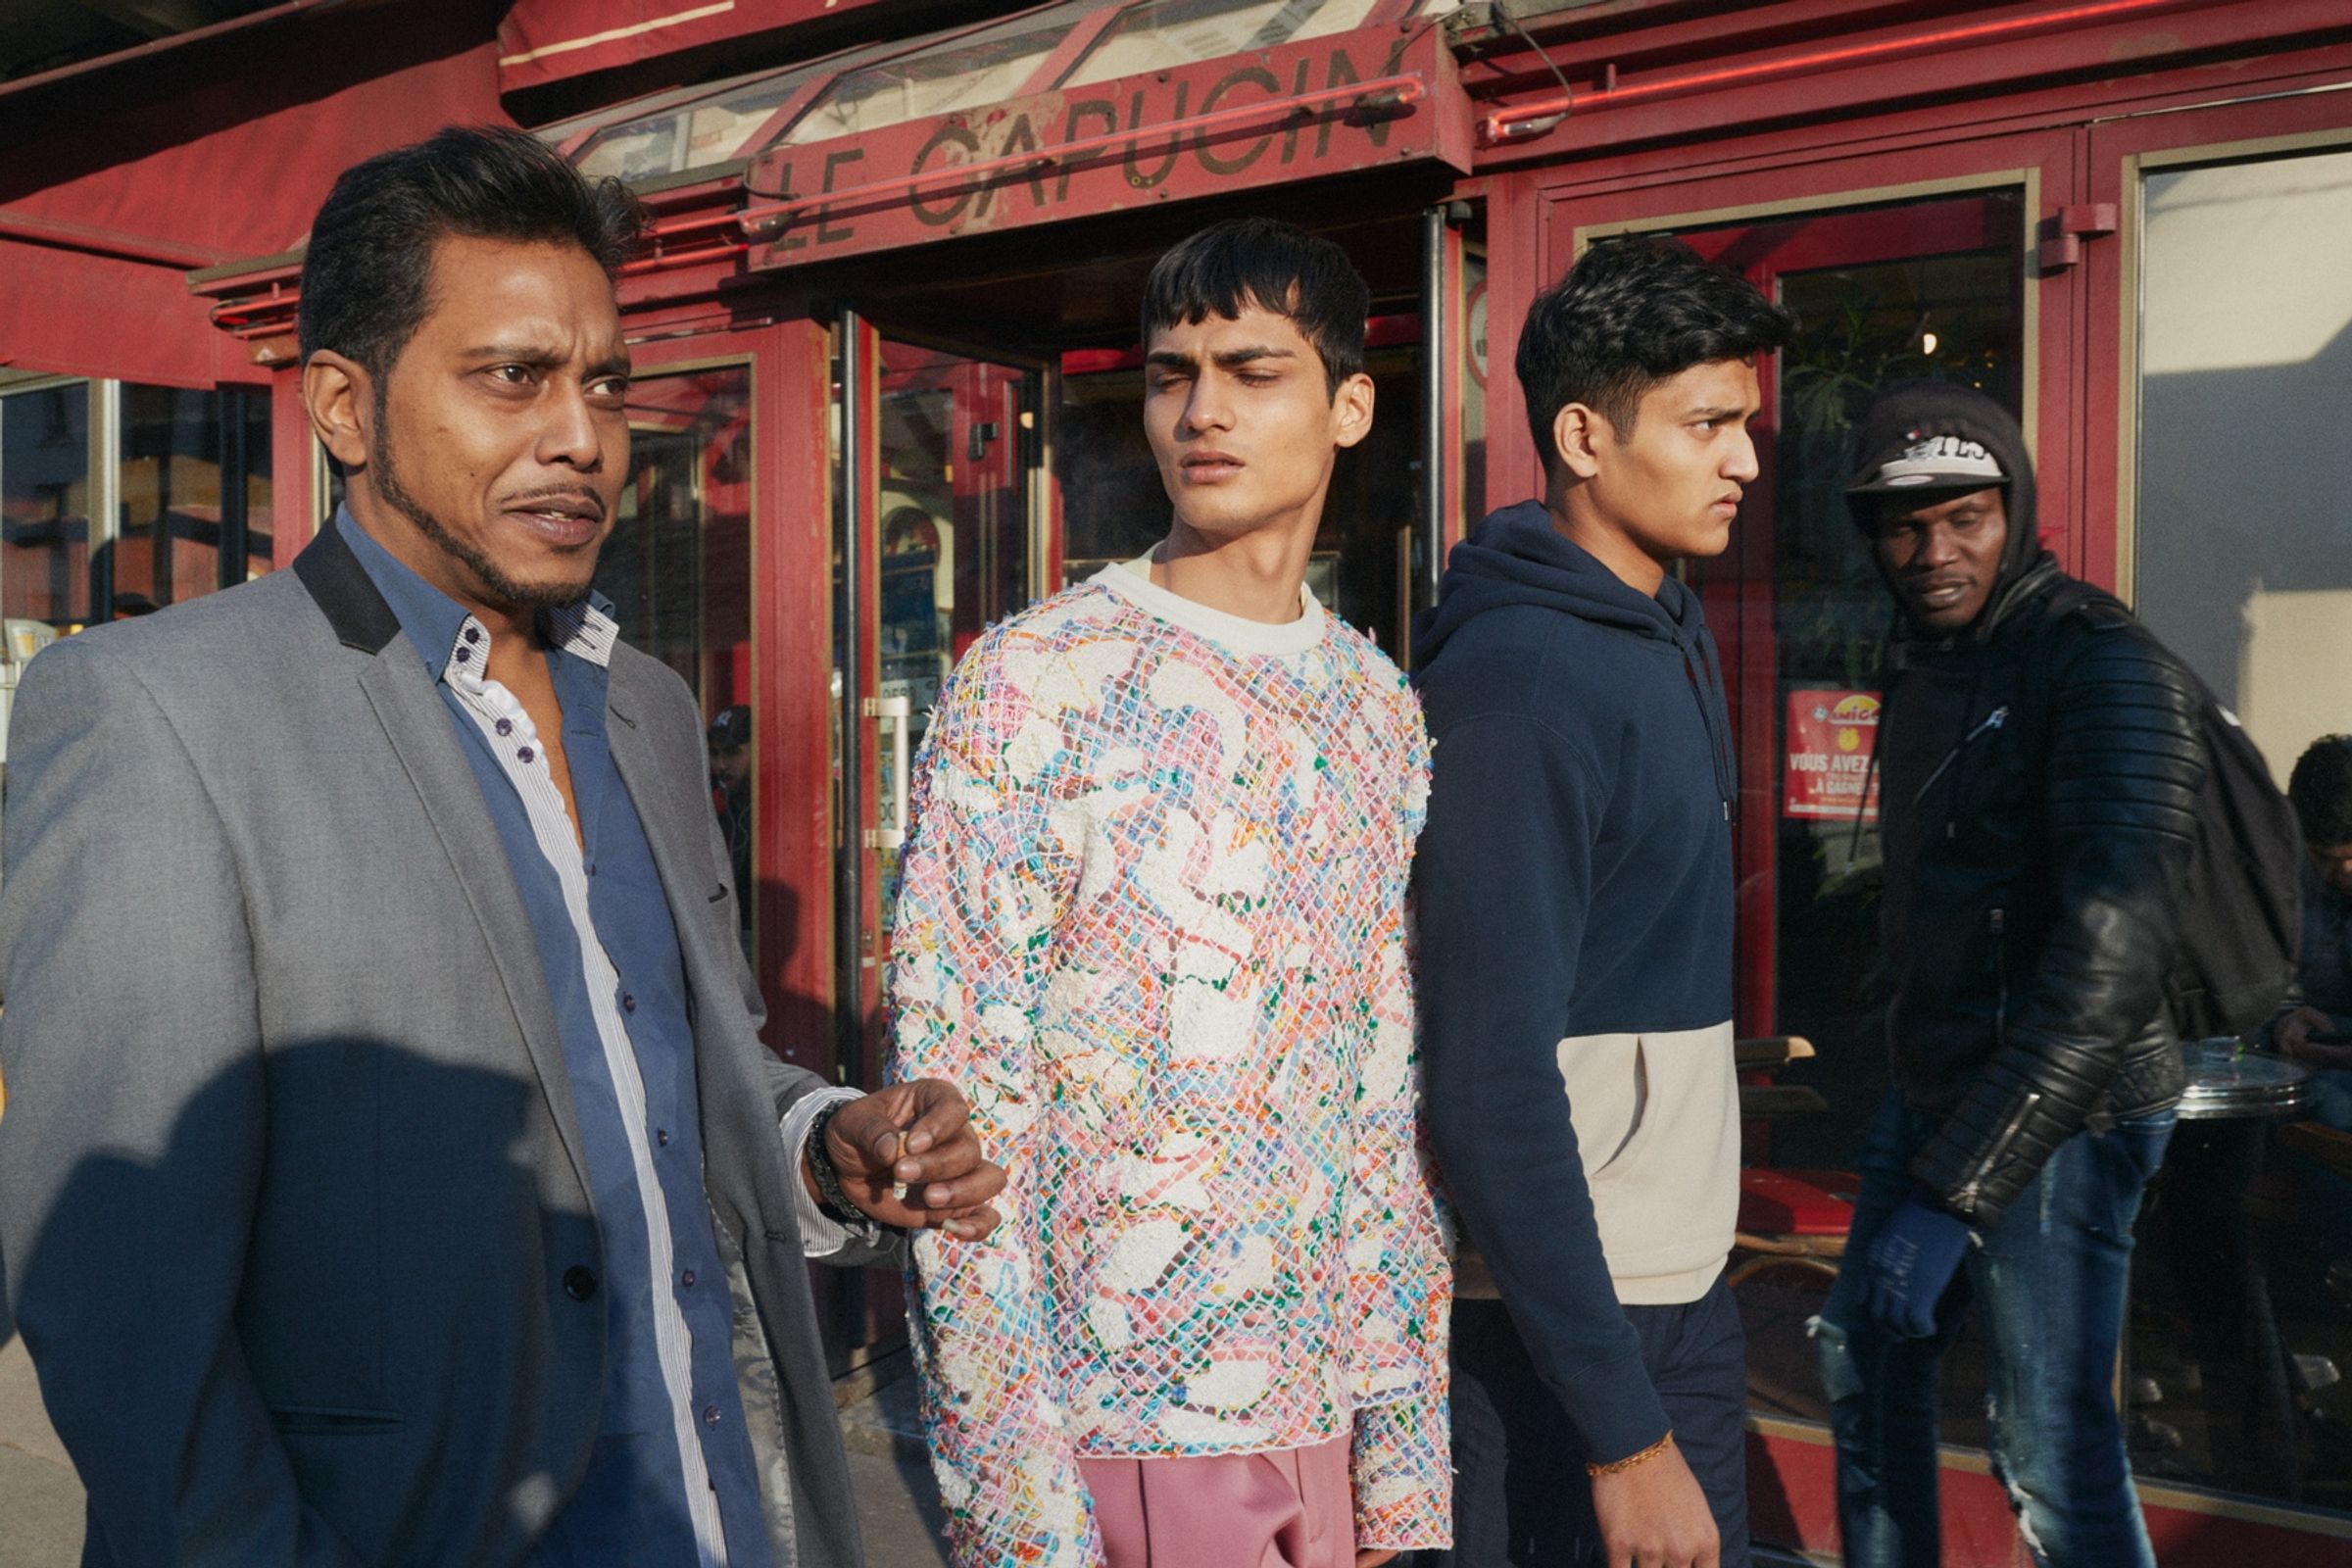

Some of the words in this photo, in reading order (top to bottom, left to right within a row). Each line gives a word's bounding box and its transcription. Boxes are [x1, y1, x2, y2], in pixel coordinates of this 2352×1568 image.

[770, 148, 864, 252] LE
[908, 39, 1406, 228] CAPUCIN
[1789, 753, 1828, 772] VOUS
[1831, 755, 1871, 773] AVEZ
